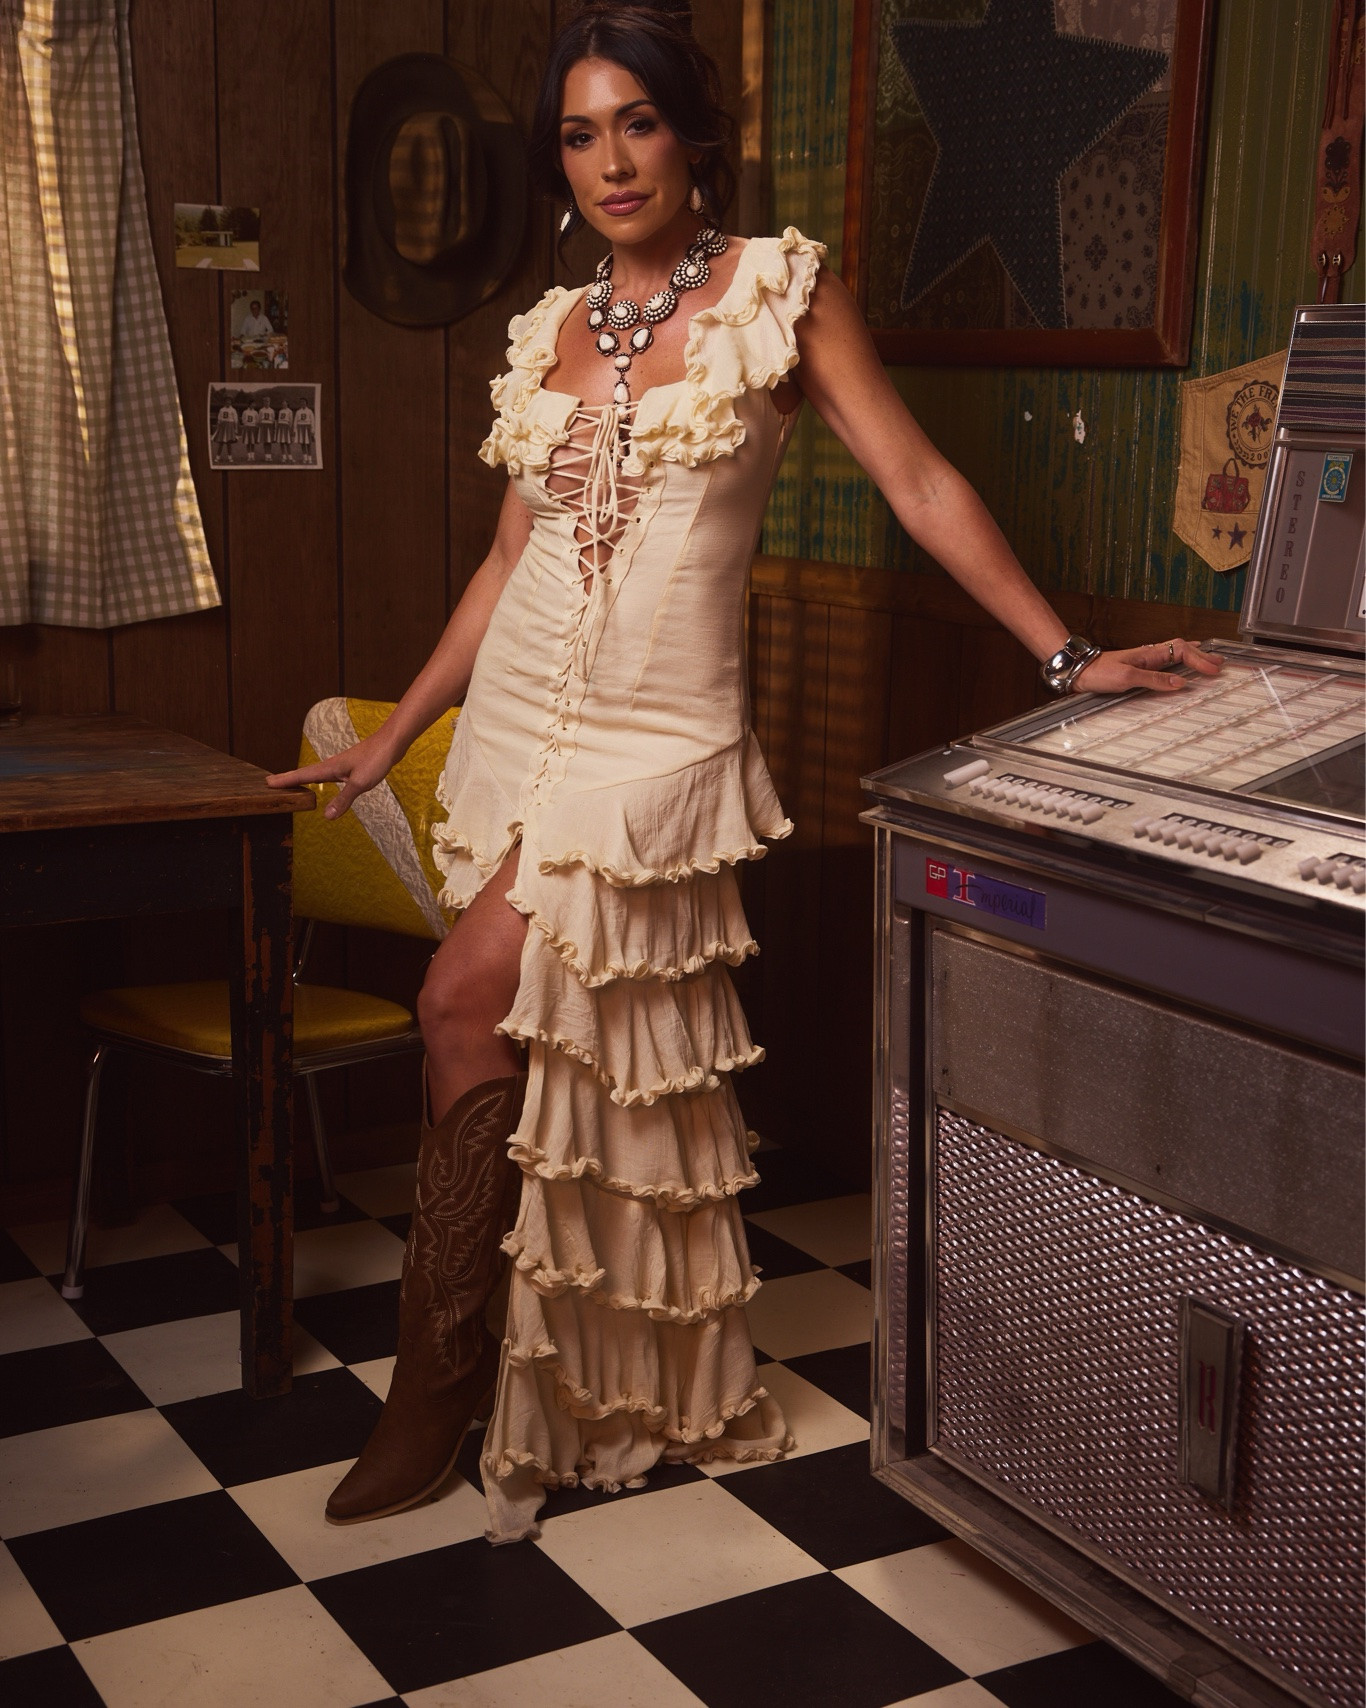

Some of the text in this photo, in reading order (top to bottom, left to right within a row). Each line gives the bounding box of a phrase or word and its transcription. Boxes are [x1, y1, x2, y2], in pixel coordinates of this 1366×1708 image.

[1230, 385, 1279, 432] WE THE FRE
[1250, 449, 1270, 462] 200
[1275, 470, 1305, 604] STEREO
[953, 868, 1036, 923] Imperial
